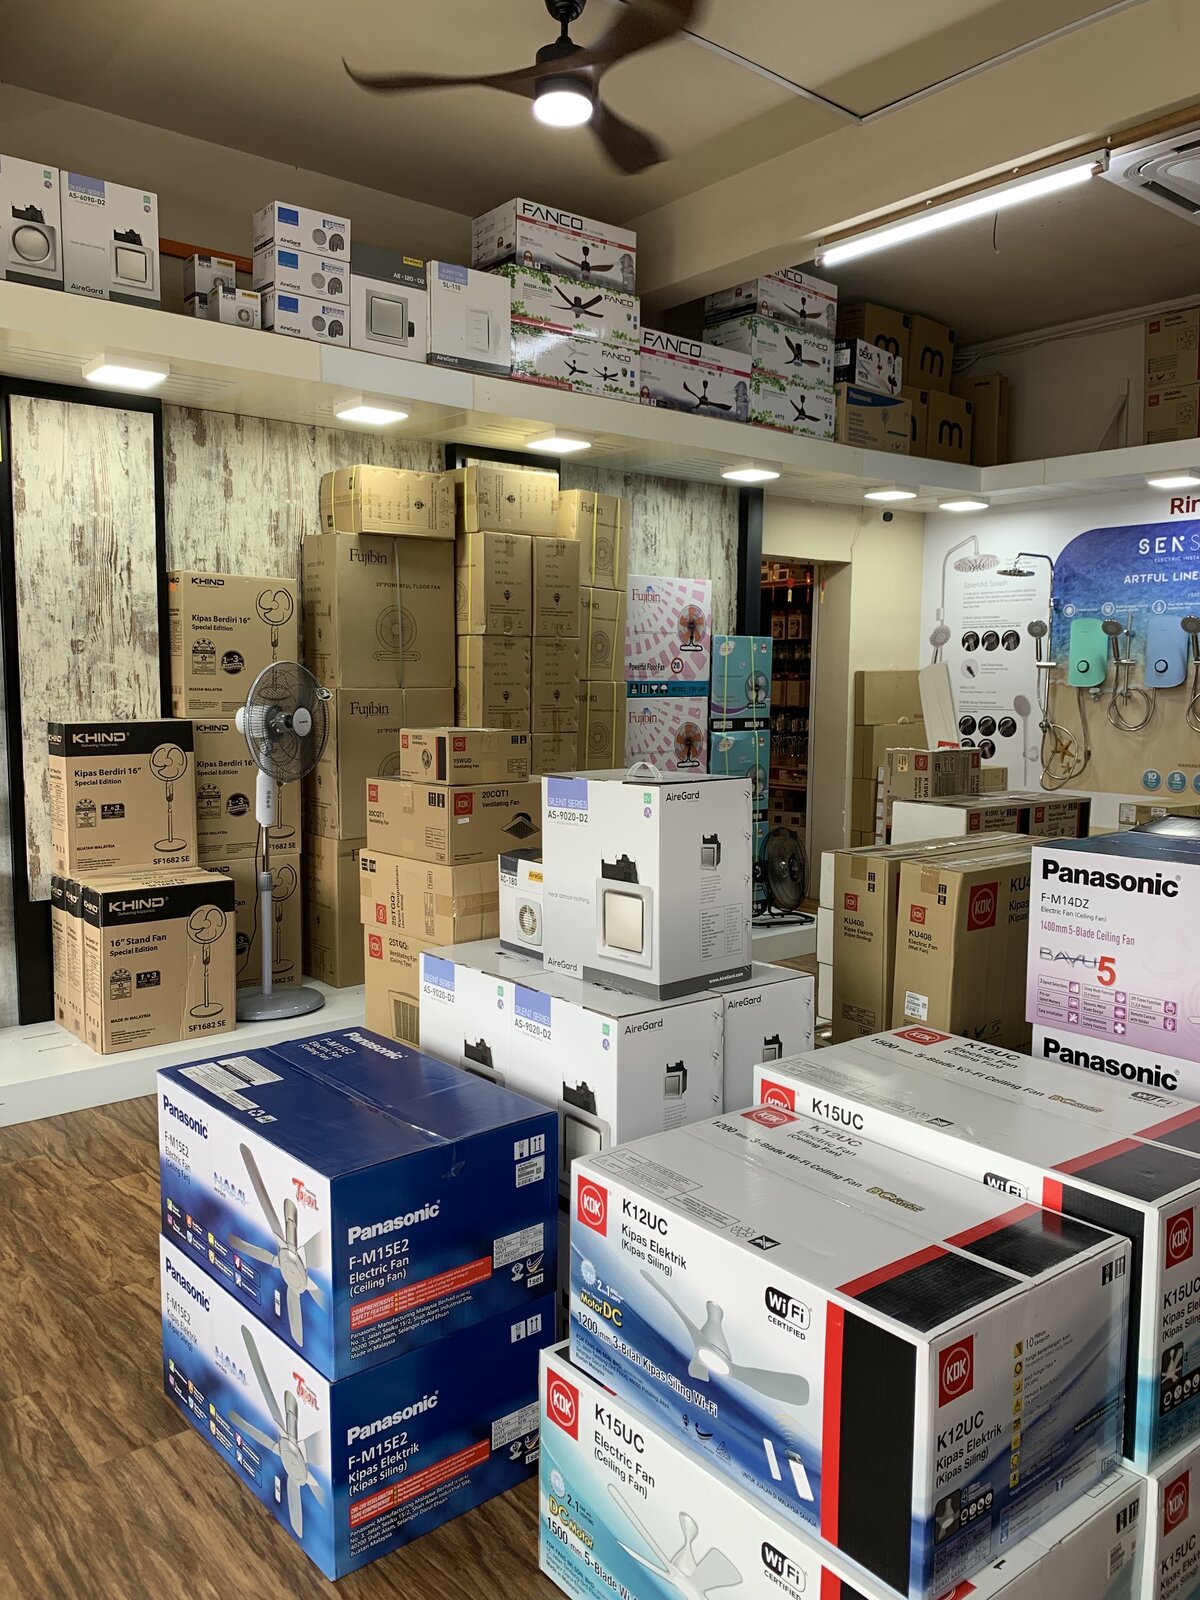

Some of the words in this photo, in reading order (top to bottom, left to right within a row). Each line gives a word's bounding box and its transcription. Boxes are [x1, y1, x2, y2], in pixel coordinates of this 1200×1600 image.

[69, 192, 105, 206] AS-6090-D2
[523, 203, 583, 230] FANCO
[71, 283, 103, 295] AireGard
[443, 282, 461, 291] SL-110
[604, 295, 633, 308] FANCO
[644, 332, 702, 358] FANCO
[804, 339, 827, 351] FANCO
[602, 351, 631, 363] FANCO
[816, 395, 832, 403] FANCO
[350, 549, 387, 567] Fujibin
[192, 578, 224, 586] KHIND
[1124, 573, 1168, 584] ARTFUL
[1173, 571, 1200, 580] LINE
[632, 589, 660, 605] Fujibin
[192, 614, 212, 623] Kipas
[647, 663, 657, 671] Floor
[350, 702, 389, 718] Fujibin
[628, 712, 657, 726] Fujibin
[72, 732, 126, 743] KHIND
[74, 770, 97, 778] Kipas
[99, 768, 126, 776] Berdiri
[482, 790, 509, 799] 20CQT1
[548, 797, 567, 807] SILENT
[567, 800, 588, 810] SERIES
[666, 790, 700, 801] AireGard
[548, 810, 588, 823] AS-9020-D2
[153, 857, 180, 865] SF1682
[501, 874, 518, 887] AC-180
[1042, 859, 1179, 897] Panasonic
[109, 897, 164, 912] KHIND
[1041, 893, 1089, 909] F-M14DZ
[1041, 906, 1061, 916] Electric
[1063, 909, 1073, 917] Fan
[1075, 911, 1094, 922] (Ceiling
[1095, 915, 1107, 923] Fan)
[126, 935, 150, 945] Stand
[909, 929, 932, 941] KU408
[1096, 930, 1120, 945] Ceiling
[1122, 934, 1135, 946] Fan
[110, 949, 134, 957] Special
[135, 945, 158, 953] Edition
[908, 939, 927, 950] Electric
[928, 943, 938, 951] Fan
[908, 945, 918, 953] (Wall
[548, 957, 578, 972] AireGard
[424, 973, 438, 984] SILENT
[423, 985, 455, 1003] AS-9020-D2
[728, 995, 761, 1010] AireGard
[515, 1005, 532, 1018] SILENT
[533, 1011, 551, 1027] SERIES
[189, 1022, 216, 1033] SF1682
[218, 1020, 226, 1028] SE
[515, 1018, 551, 1040] AS-9020-D2
[624, 1019, 663, 1035] AireGard
[343, 1032, 403, 1060] Panasonic
[964, 1042, 1021, 1062] K15UC
[1043, 1037, 1177, 1091] Panasonic
[163, 1094, 208, 1140] Panasonic
[812, 1098, 864, 1130] K15UC
[164, 1131, 189, 1158] F-M15E2
[809, 1125, 862, 1148] K12UC
[165, 1145, 181, 1166] Electric
[182, 1159, 191, 1172] Fan
[712, 1121, 737, 1134] 1200
[750, 1138, 786, 1156] 3-Blade
[786, 1153, 810, 1166] Wi-Fi
[810, 1164, 844, 1181] Ceiling
[843, 1176, 862, 1188] Fan
[348, 1203, 440, 1245] Panasonic
[622, 1198, 668, 1236] K12UC
[349, 1238, 409, 1270] F-M15E2
[622, 1223, 647, 1248] Kipas
[650, 1240, 687, 1269] Elektrik
[621, 1239, 645, 1260] (Kipas
[647, 1253, 673, 1277] Siling)
[350, 1264, 388, 1284] Electric
[391, 1257, 409, 1271] Fan
[166, 1257, 210, 1312] Panasonic
[350, 1276, 384, 1298] (Ceiling
[387, 1268, 407, 1283] Fan)
[167, 1293, 191, 1325] F-M15E2
[1162, 1308, 1185, 1327] Kipas
[767, 1315, 805, 1340] CERTIFIED
[578, 1311, 598, 1335] 1200
[598, 1330, 611, 1344] mm
[612, 1335, 641, 1365] 3-Bilah
[642, 1355, 666, 1382] Kipas
[667, 1373, 691, 1403] Siling
[693, 1390, 718, 1418] Wi-Fi
[946, 1357, 967, 1384] KDK
[347, 1395, 438, 1446] Panasonic
[595, 1403, 645, 1454] K15UC
[937, 1410, 984, 1452] K12UC
[348, 1432, 408, 1470] F-M15E2
[936, 1449, 964, 1472] Kipas
[967, 1423, 1002, 1454] Elektrik
[349, 1462, 378, 1484] Kipas
[380, 1442, 420, 1468] Elektrik
[595, 1430, 632, 1470] Electric
[635, 1462, 655, 1488] Fan
[936, 1466, 962, 1489] (Kipas
[964, 1447, 989, 1469] Siling)
[349, 1470, 378, 1496] (Kipas
[380, 1460, 408, 1480] Siling)
[594, 1447, 626, 1483] (Ceiling
[628, 1476, 648, 1499] Fan)
[1161, 1534, 1196, 1575] K15UC
